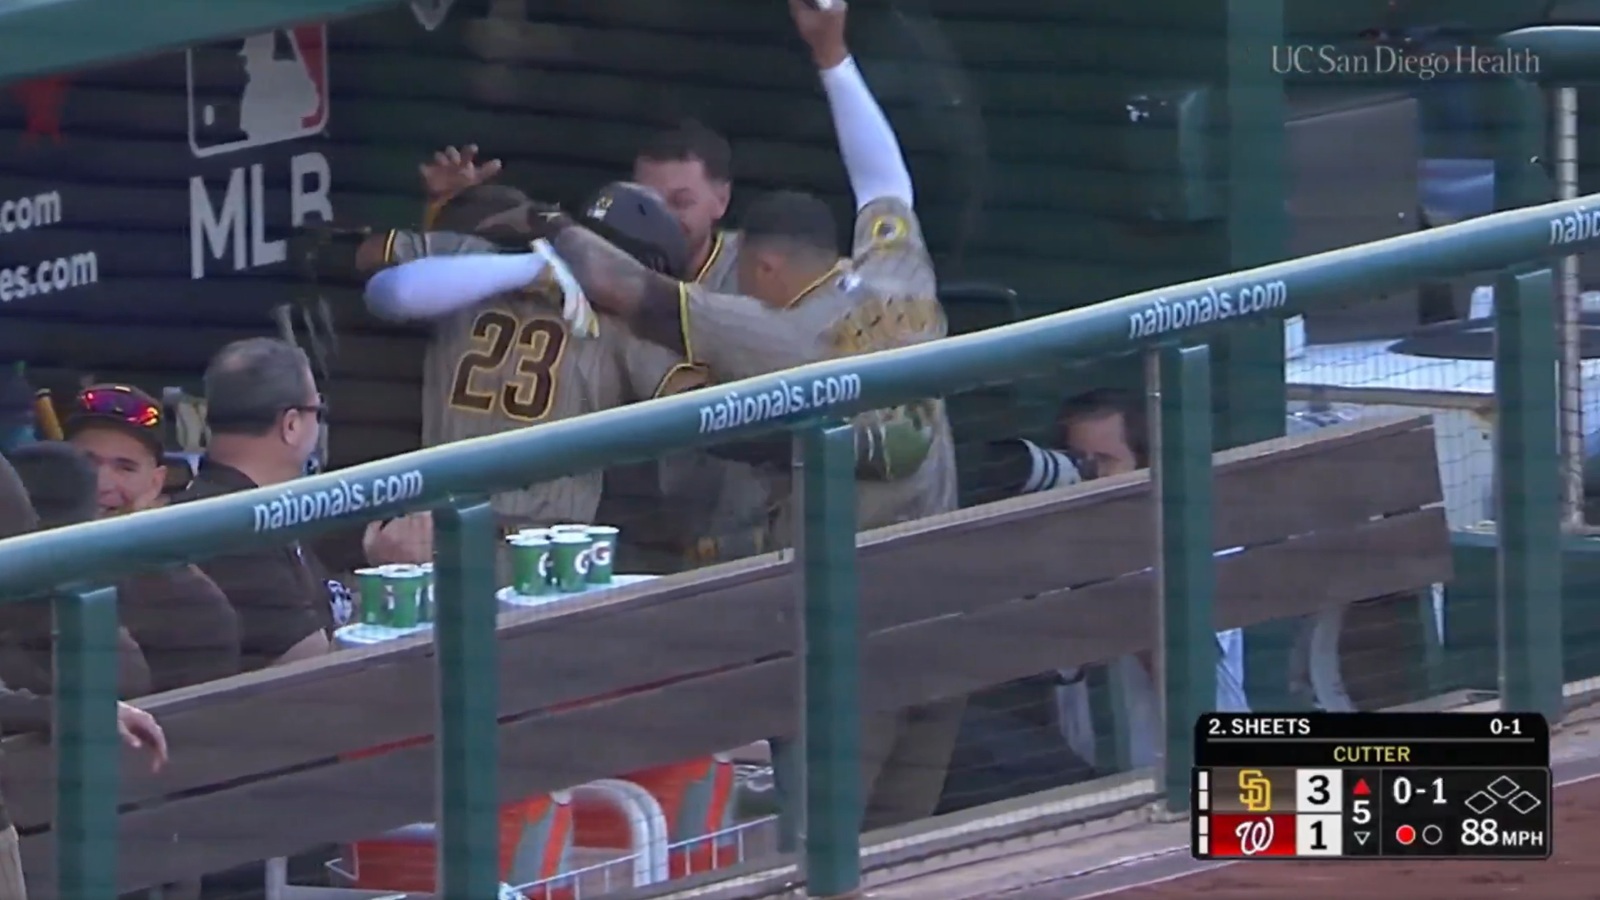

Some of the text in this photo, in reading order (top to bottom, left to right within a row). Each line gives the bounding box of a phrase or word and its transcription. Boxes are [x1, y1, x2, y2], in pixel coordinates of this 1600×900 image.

[189, 152, 333, 279] MLB
[1128, 279, 1287, 339] nationals.com
[450, 310, 567, 421] 23
[699, 372, 861, 434] nationals.com
[253, 468, 423, 532] nationals.com
